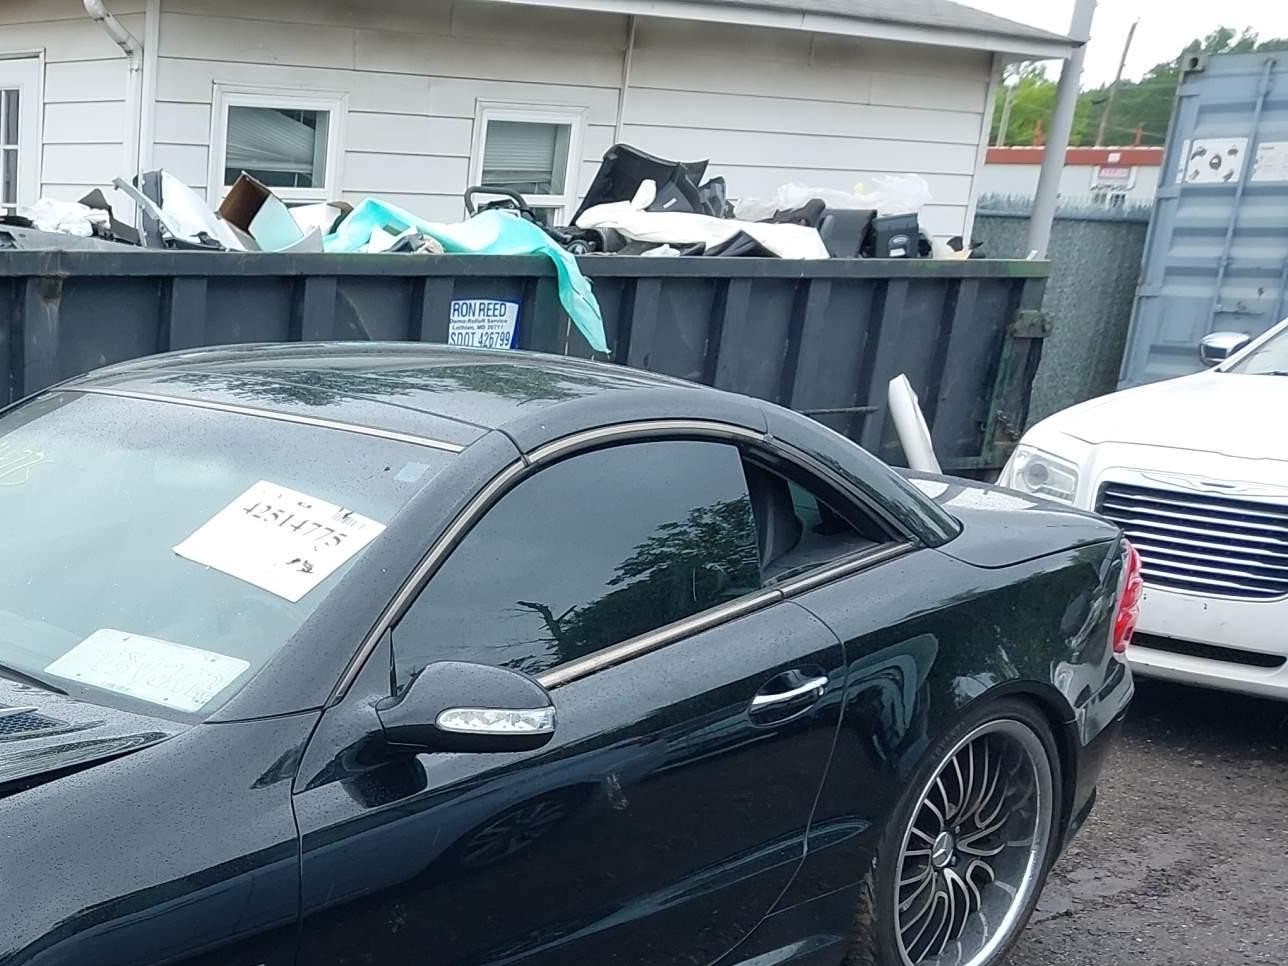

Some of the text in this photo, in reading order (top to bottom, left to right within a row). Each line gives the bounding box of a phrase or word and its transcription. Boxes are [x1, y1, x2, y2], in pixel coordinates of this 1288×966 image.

[452, 302, 507, 318] RON REED
[478, 331, 511, 349] 426799
[242, 502, 348, 547] 42514775
